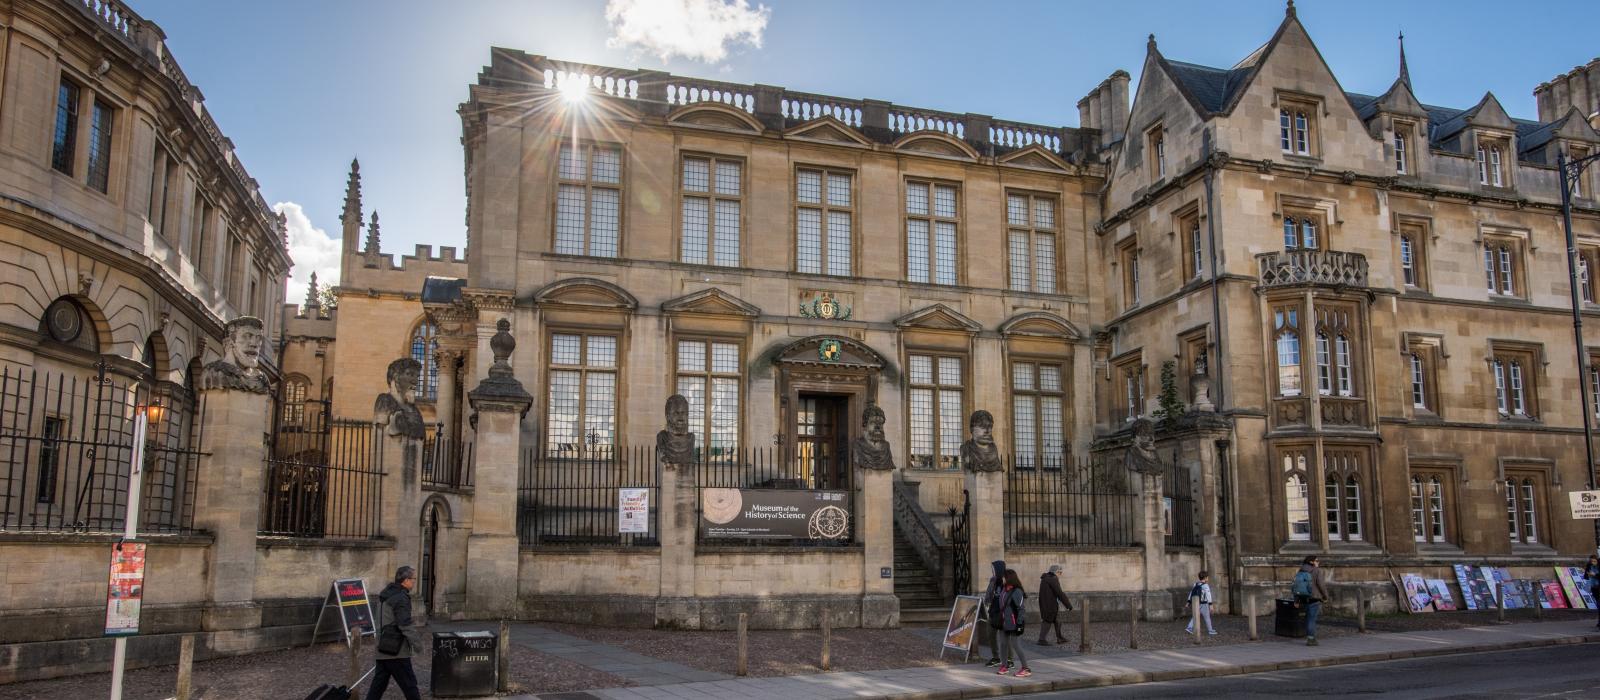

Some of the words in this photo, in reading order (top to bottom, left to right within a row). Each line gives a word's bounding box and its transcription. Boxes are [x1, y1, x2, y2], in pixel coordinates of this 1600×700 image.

[752, 503, 783, 511] Museum
[745, 511, 771, 520] History
[778, 511, 806, 519] Science
